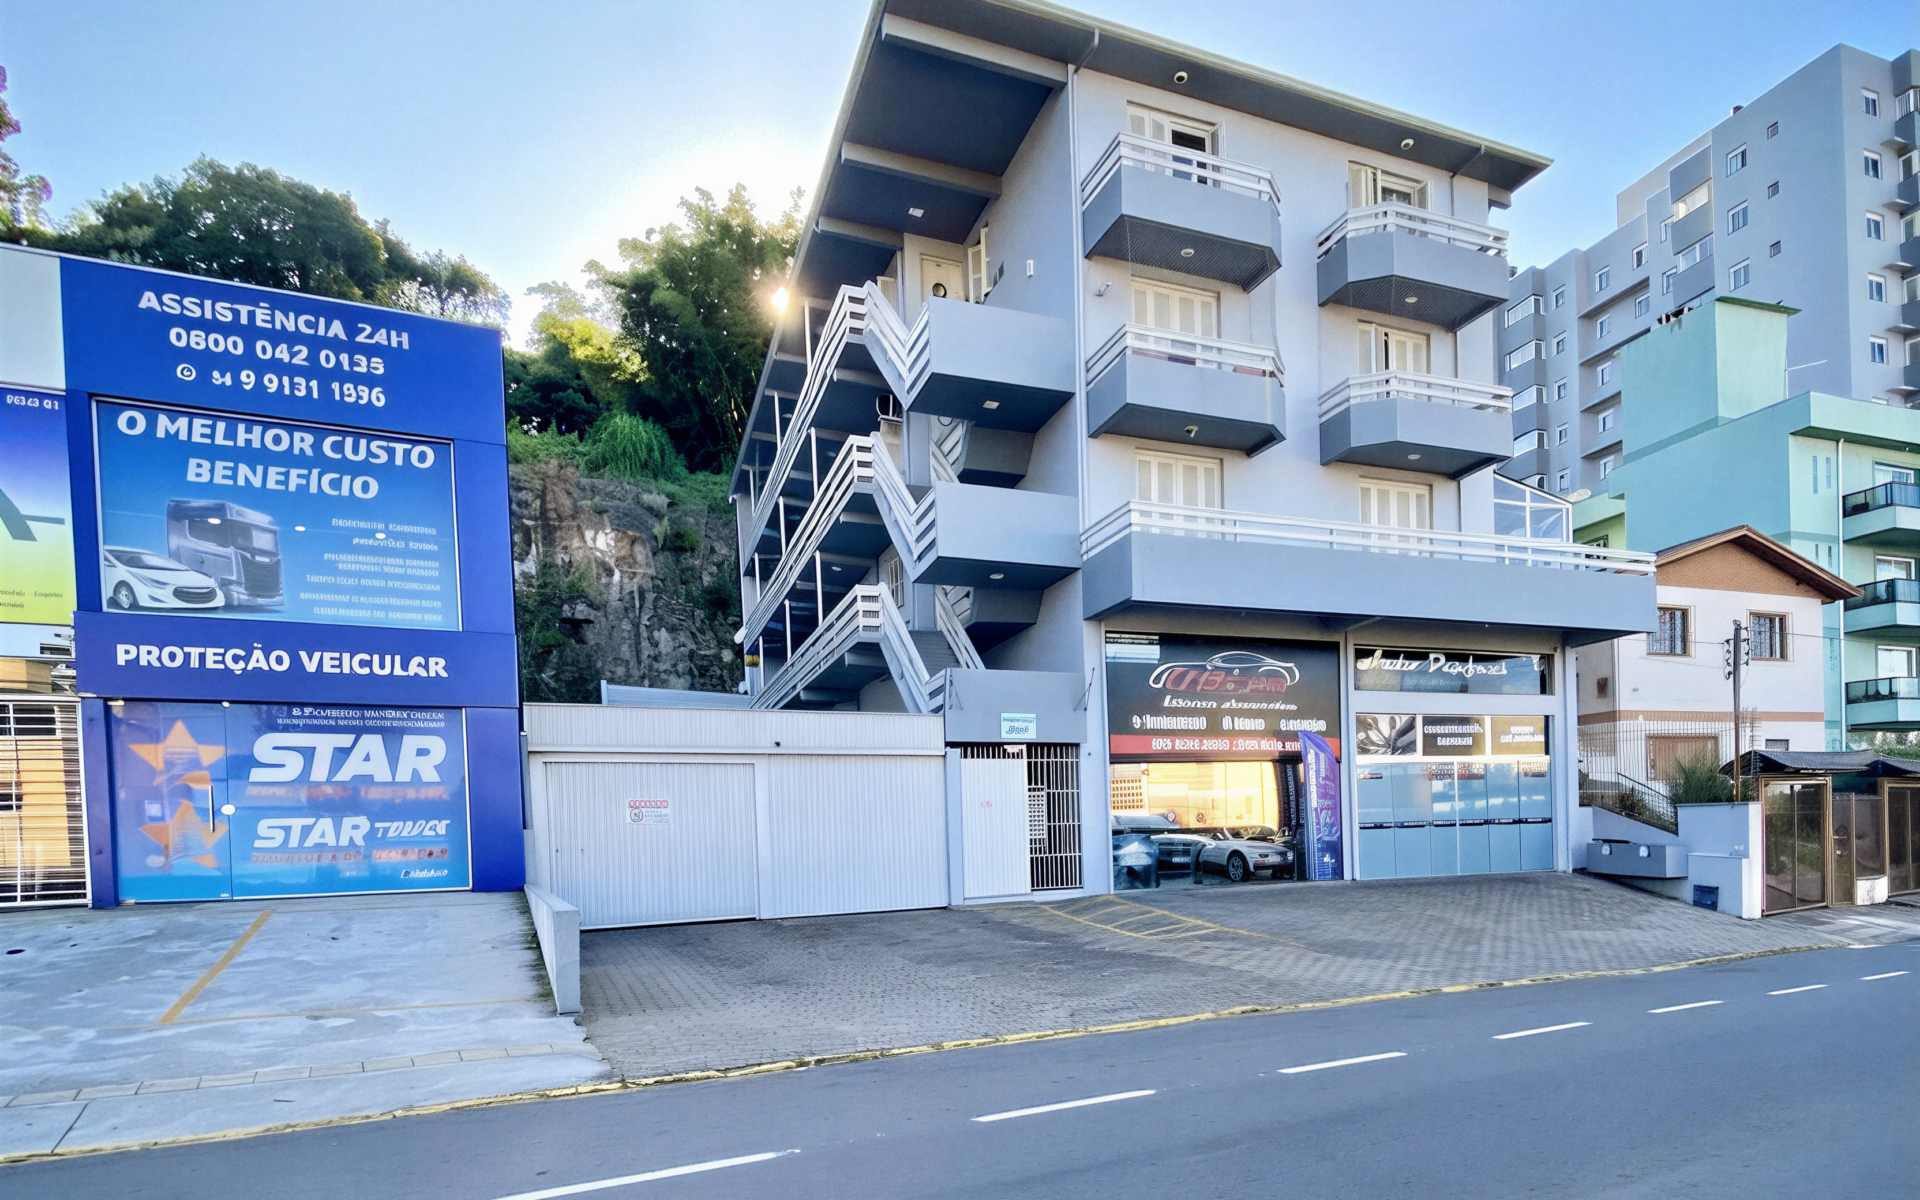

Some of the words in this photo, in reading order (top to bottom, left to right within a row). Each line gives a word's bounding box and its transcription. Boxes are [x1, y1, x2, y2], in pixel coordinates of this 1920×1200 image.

[255, 340, 313, 366] 042
[355, 323, 409, 350] 24H
[239, 369, 256, 391] 9
[263, 373, 319, 399] 9131
[117, 410, 147, 436] O
[156, 413, 315, 456] MELHOR
[322, 435, 435, 469] CUSTO
[186, 458, 379, 499] BENEFÍCIO
[116, 642, 291, 675] PROTEÇÃO
[298, 650, 449, 678] VEICULAR
[248, 732, 447, 783] STAR
[253, 816, 371, 849] STAR
